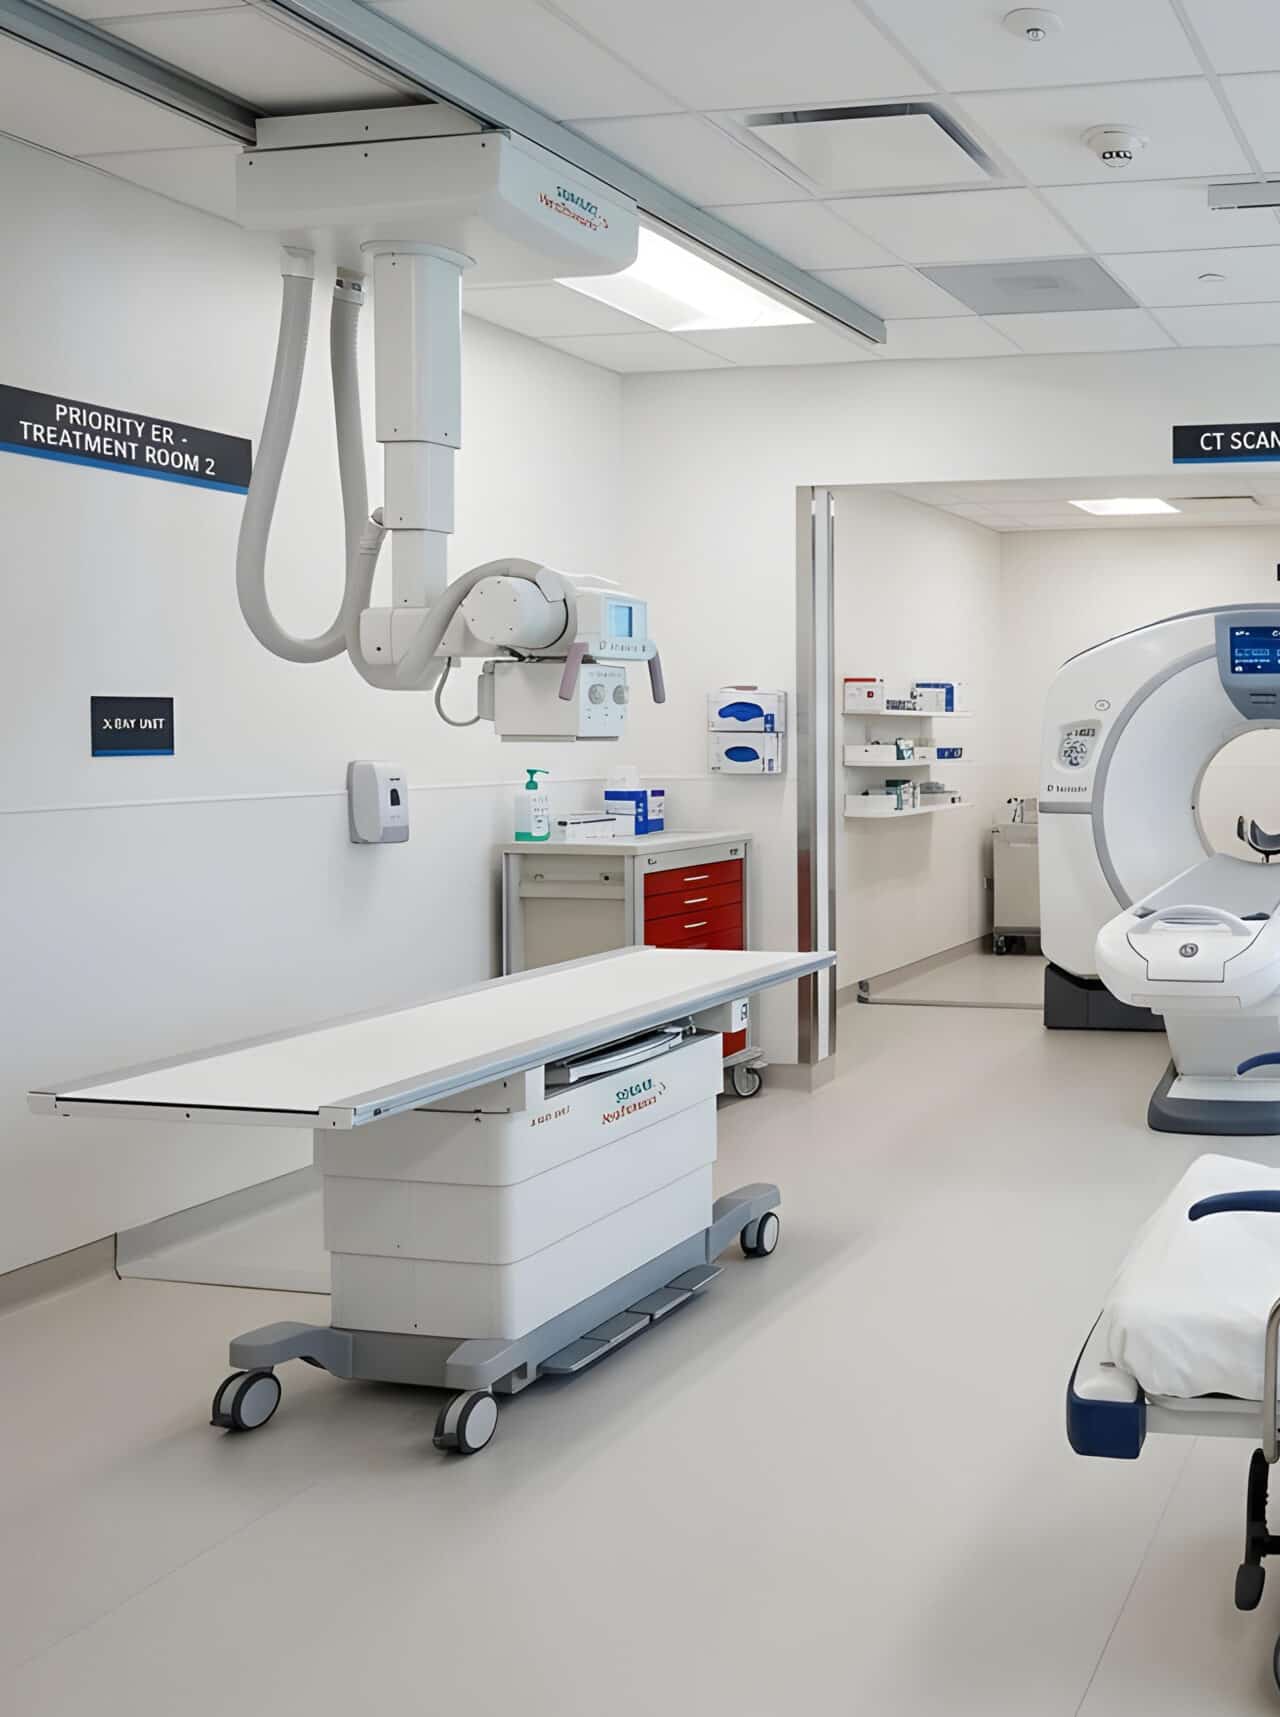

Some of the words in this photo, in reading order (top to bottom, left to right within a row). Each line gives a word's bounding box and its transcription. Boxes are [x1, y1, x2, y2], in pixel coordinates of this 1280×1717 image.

[56, 404, 145, 438] PRIORITY
[152, 424, 174, 445] ER
[1200, 432, 1224, 451] CT
[19, 421, 138, 460] TREATMENT
[146, 446, 199, 472] ROOM
[205, 458, 215, 475] 2
